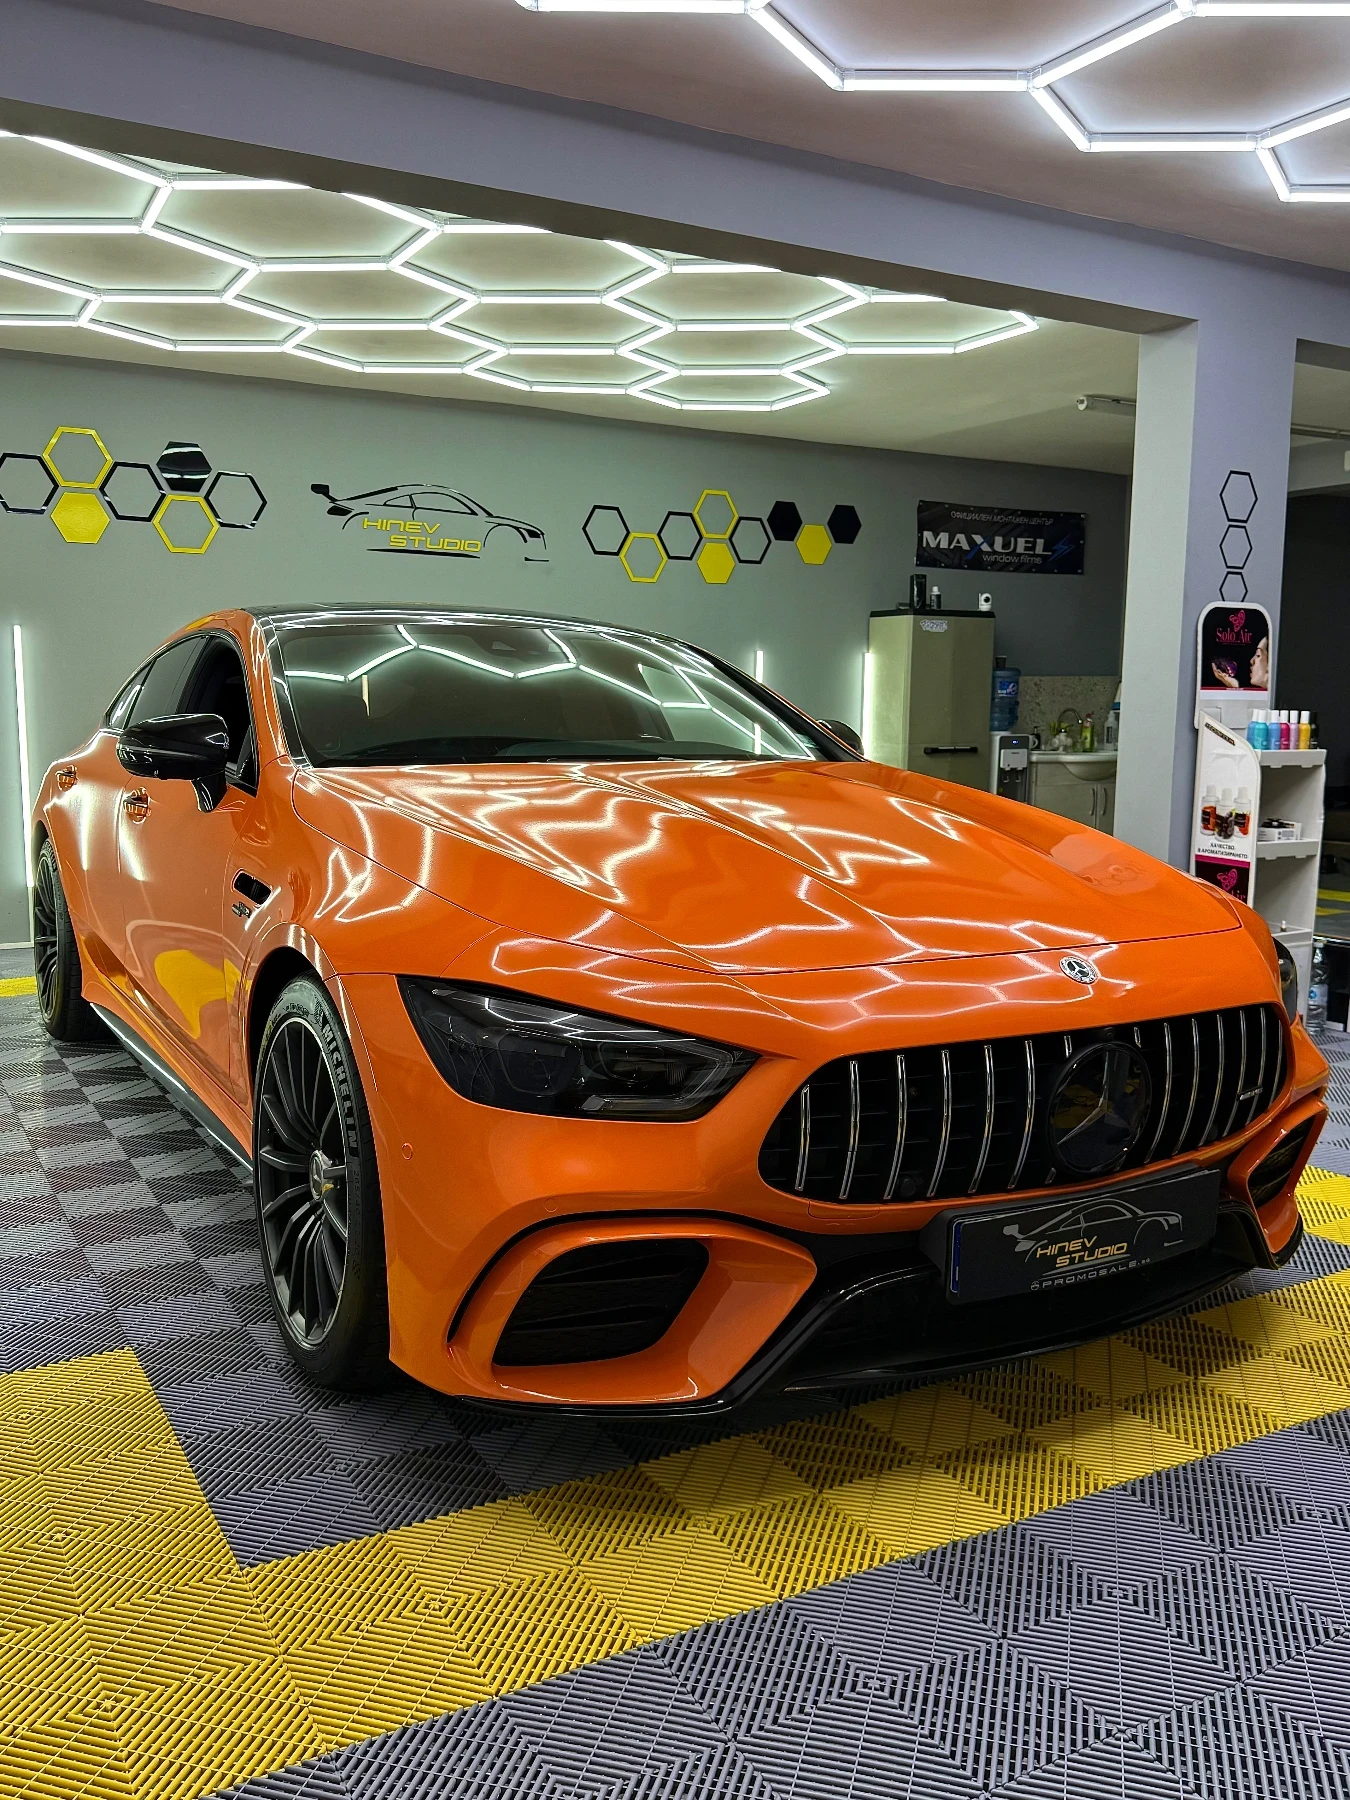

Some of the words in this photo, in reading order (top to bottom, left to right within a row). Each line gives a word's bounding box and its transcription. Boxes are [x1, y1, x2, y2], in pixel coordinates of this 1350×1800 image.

[363, 518, 440, 534] HINEV
[389, 534, 482, 552] STUDIO
[922, 531, 1053, 559] MAXUEL
[982, 554, 1019, 563] window
[1020, 555, 1043, 565] films
[1216, 628, 1236, 642] Solo
[1239, 629, 1253, 643] Air
[322, 1023, 358, 1148] MICHELIN
[1036, 1235, 1098, 1259] HINEV
[1055, 1242, 1128, 1268] STUDIO
